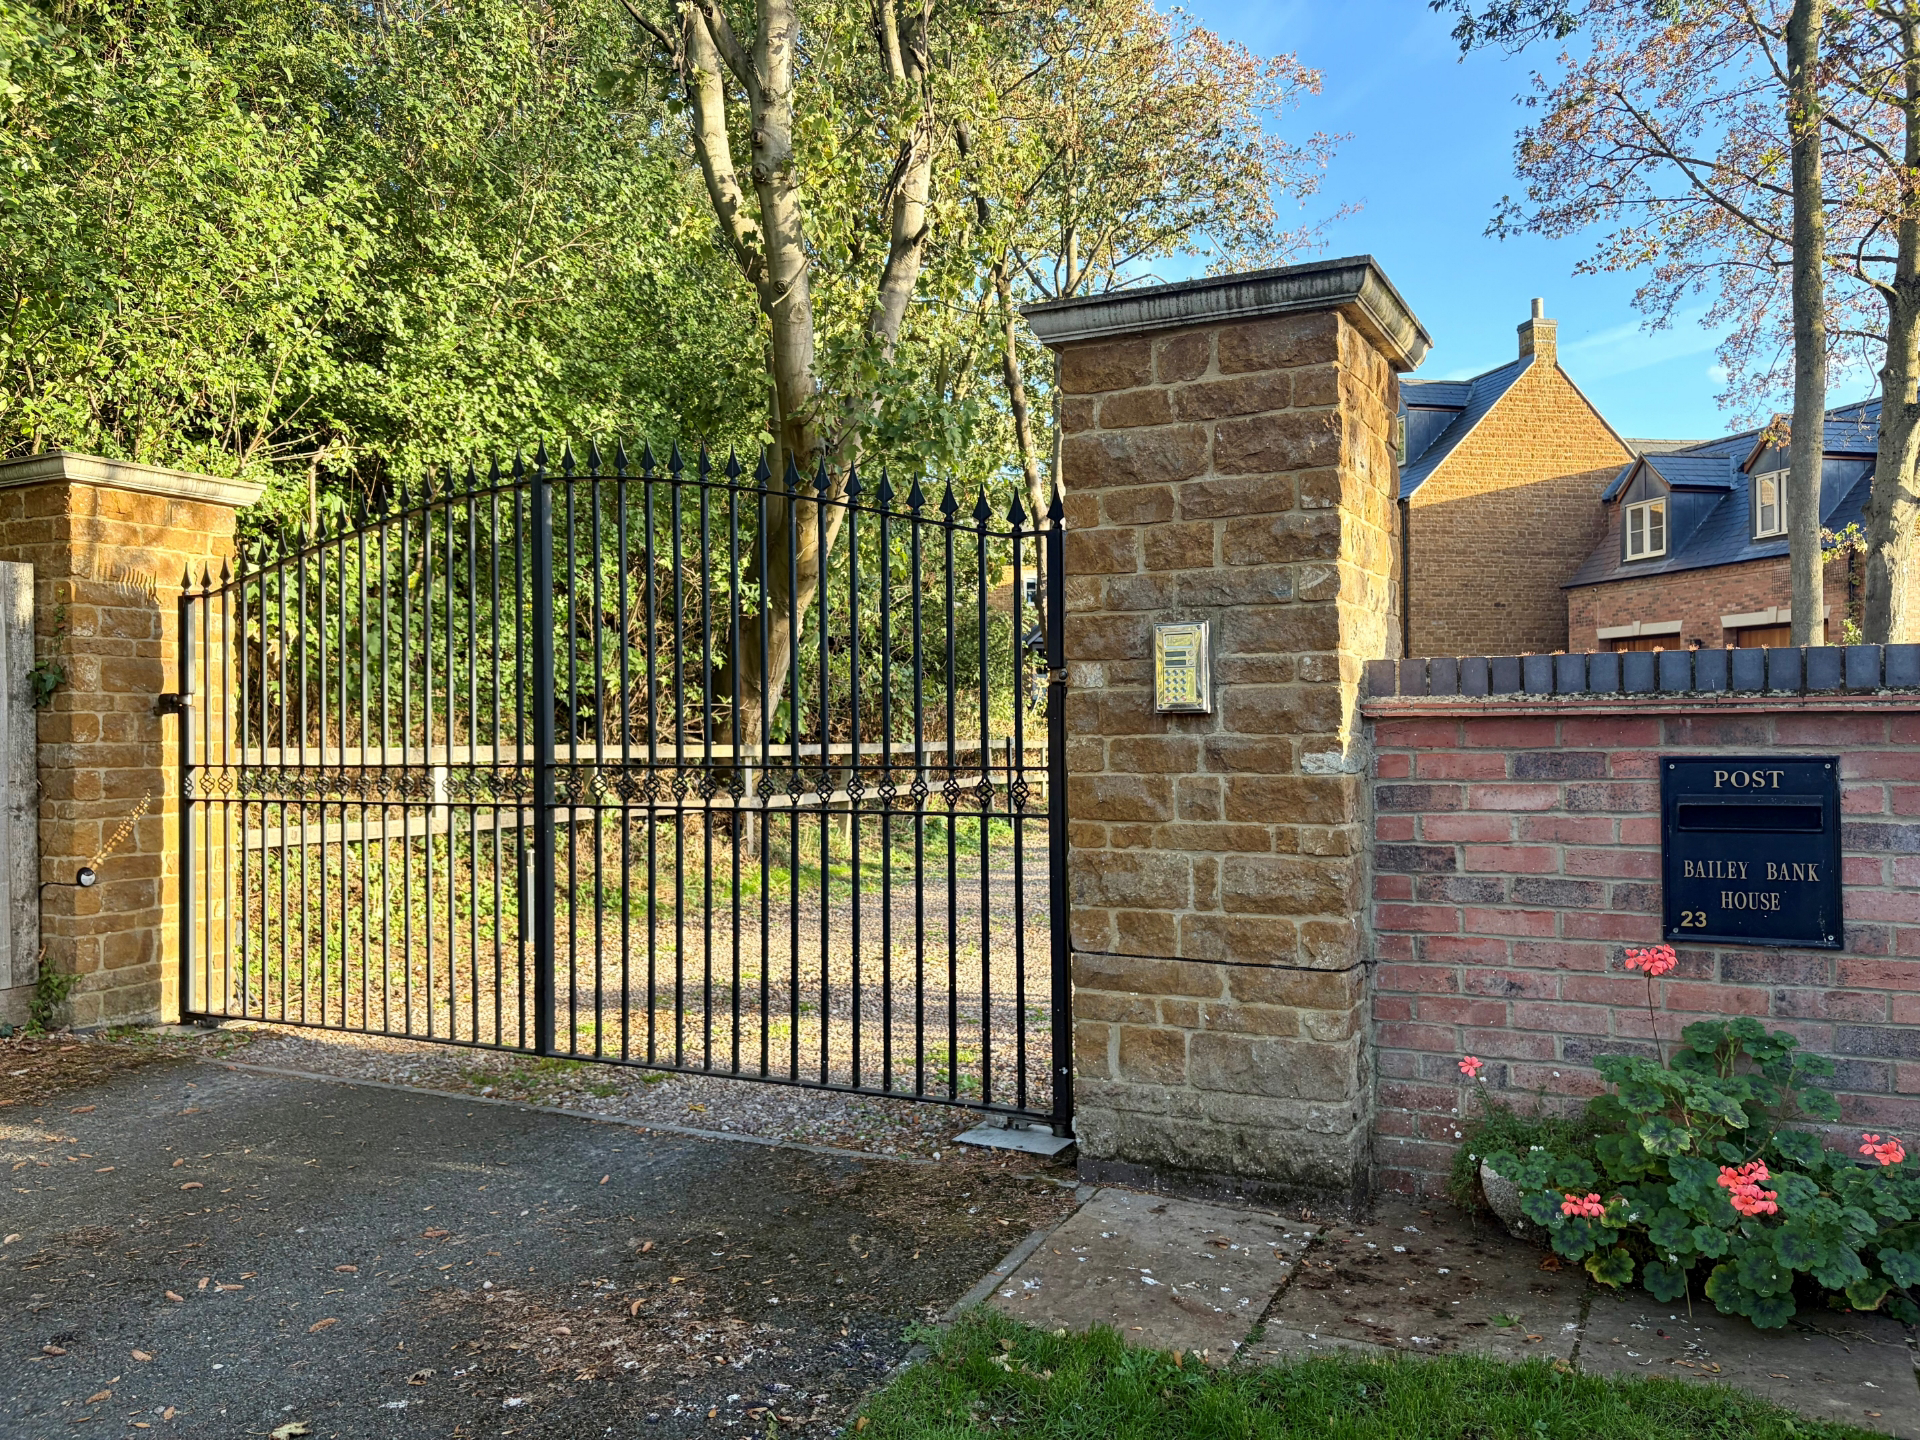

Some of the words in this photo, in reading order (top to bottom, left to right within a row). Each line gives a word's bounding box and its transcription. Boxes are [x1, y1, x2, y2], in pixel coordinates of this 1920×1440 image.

[1713, 770, 1785, 788] POST
[1683, 860, 1750, 880] BAILEY
[1766, 862, 1820, 882] BANK
[1720, 891, 1780, 911] HOUSE
[1680, 911, 1707, 928] 23
